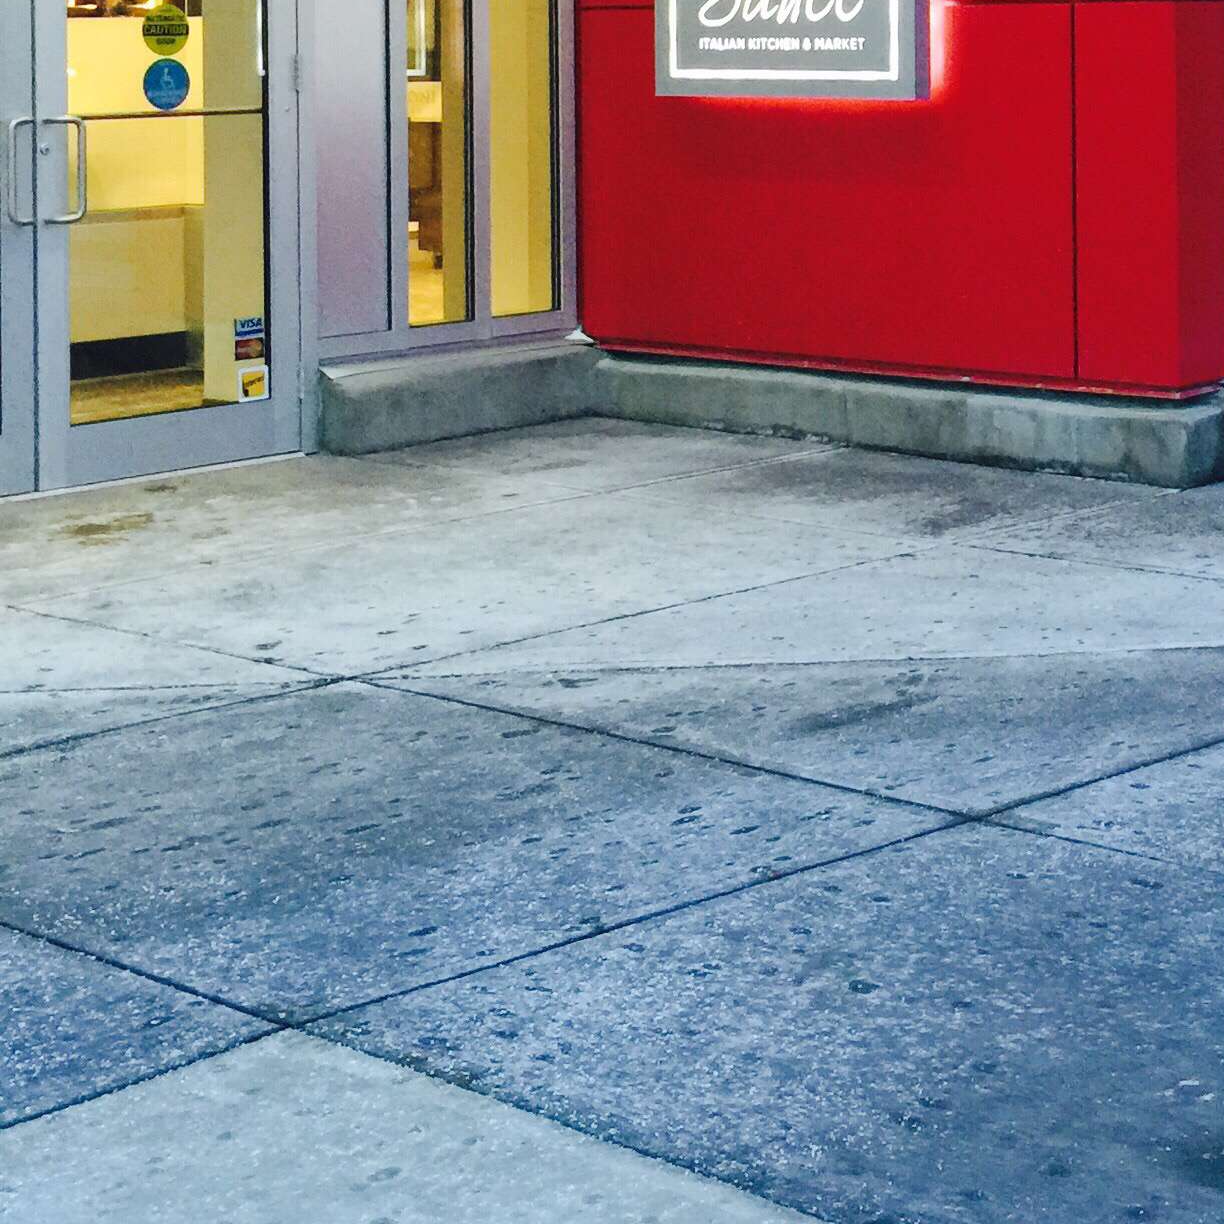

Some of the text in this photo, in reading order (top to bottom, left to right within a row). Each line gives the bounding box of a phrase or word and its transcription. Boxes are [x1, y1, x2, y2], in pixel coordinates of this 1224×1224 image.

[699, 37, 866, 51] ITALIAN KITCHEN & MARKET
[239, 318, 262, 329] VISA
